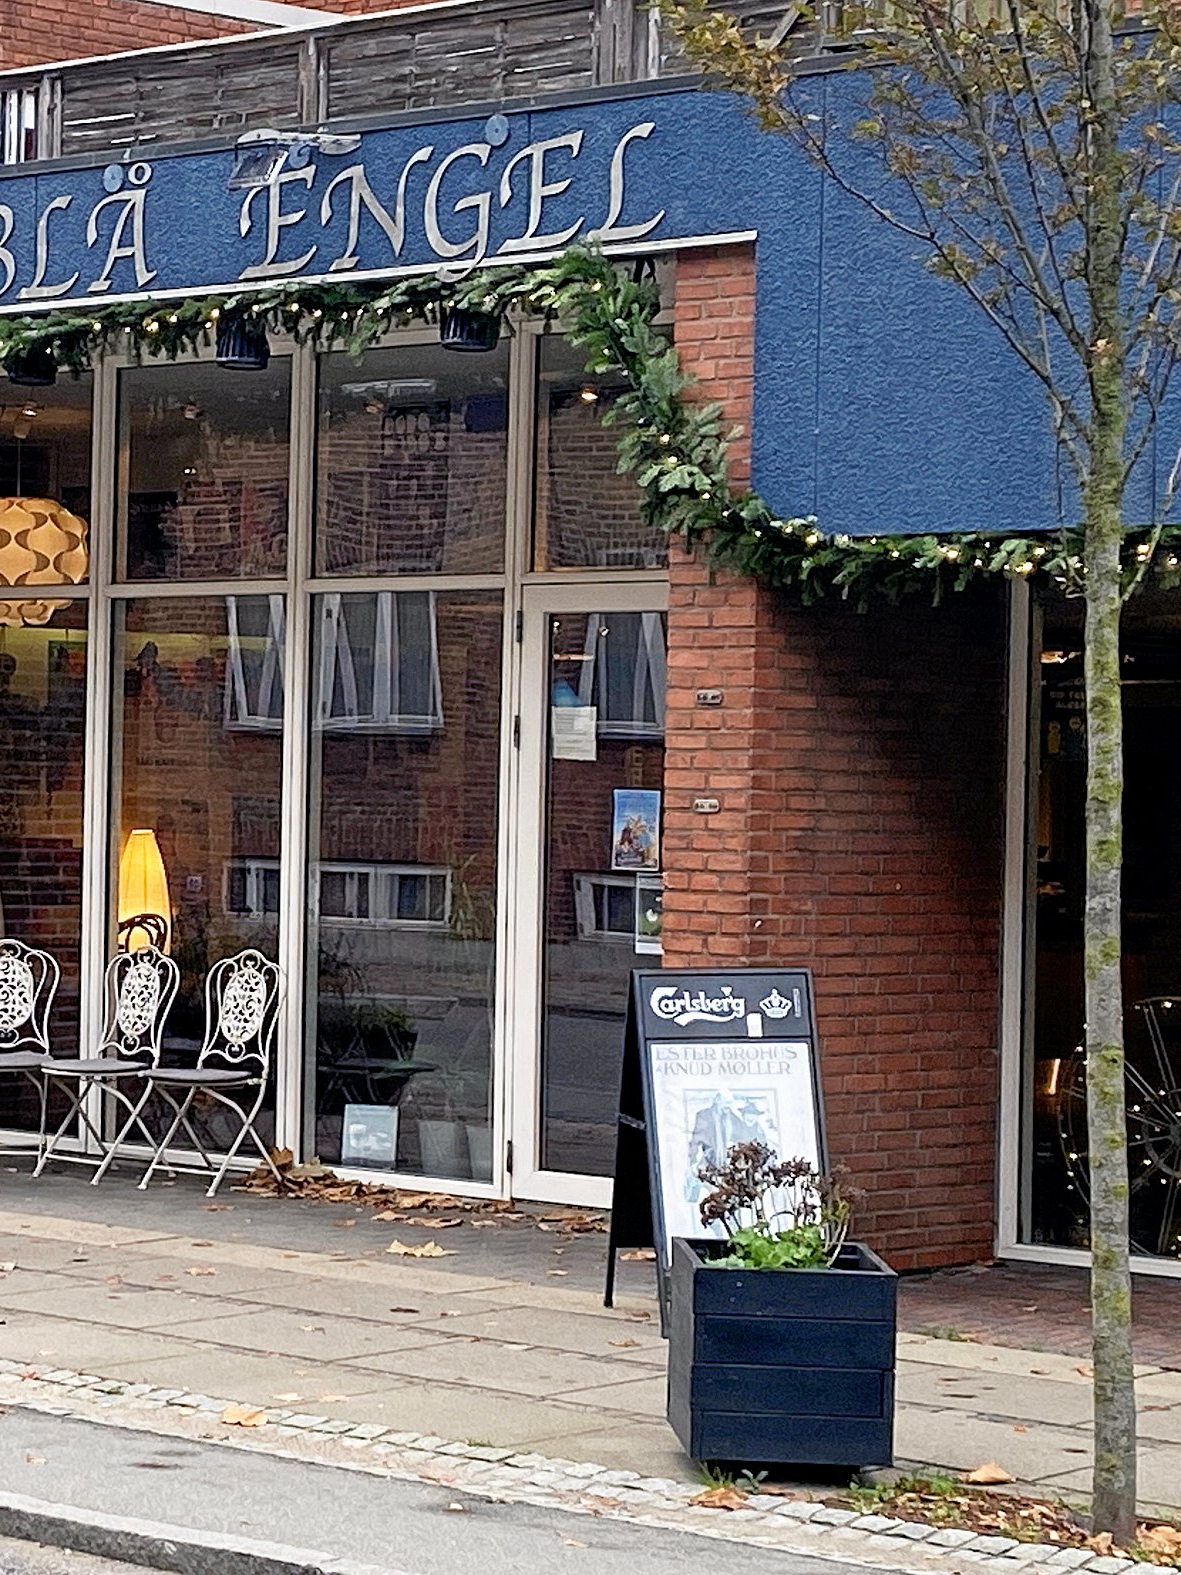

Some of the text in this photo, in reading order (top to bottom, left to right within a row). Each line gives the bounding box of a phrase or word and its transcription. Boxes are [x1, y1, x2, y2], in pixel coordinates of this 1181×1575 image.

[238, 121, 665, 283] ENGEL
[650, 986, 745, 1027] Carlsberg
[655, 1045, 798, 1061] ESTER BROHUS
[664, 1061, 713, 1075] KNUD
[718, 1061, 791, 1075] MØLLER
